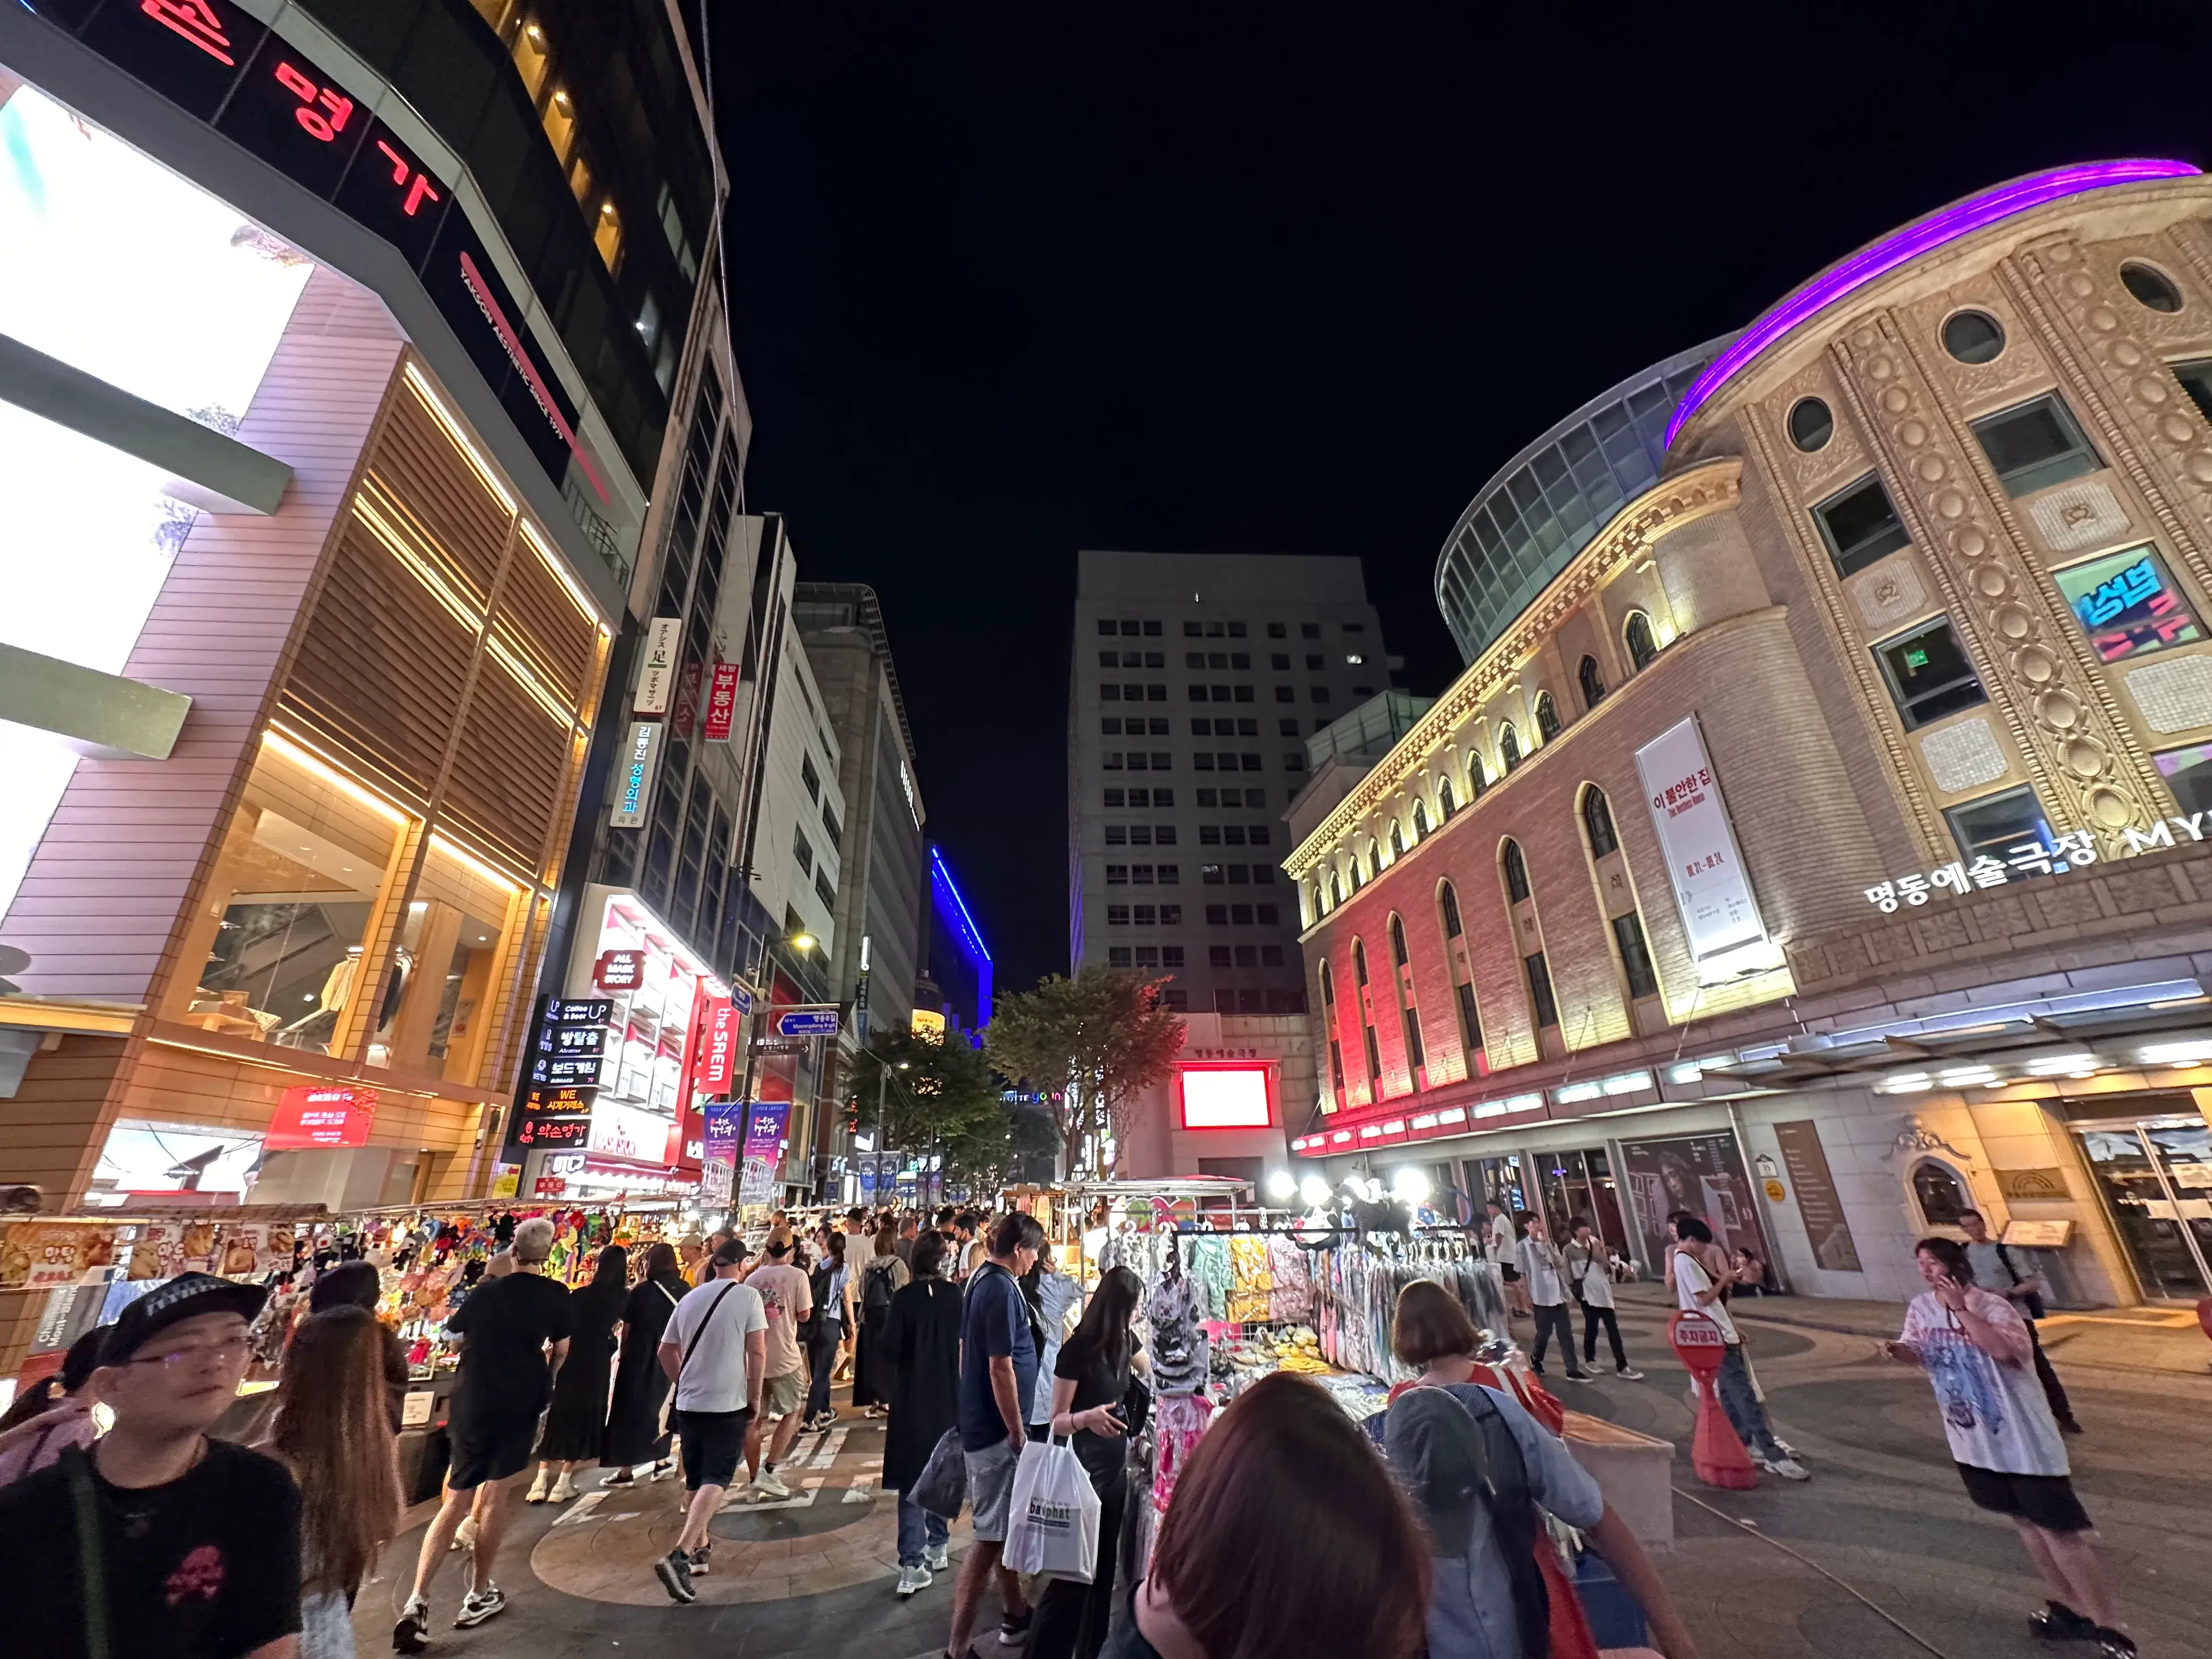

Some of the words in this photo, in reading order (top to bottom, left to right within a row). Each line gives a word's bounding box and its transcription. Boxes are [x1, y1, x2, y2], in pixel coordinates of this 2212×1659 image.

[460, 267, 494, 325] YAKSON
[492, 324, 532, 385] AESTHETIC
[531, 384, 550, 419] SINCE
[547, 415, 564, 441] 1979
[651, 650, 666, 663] 足
[710, 674, 734, 724] 부동산
[1654, 792, 1666, 809] 이
[1665, 774, 1699, 805] 불안한
[1697, 767, 1712, 786] 집
[1864, 830, 2097, 913] 명동예술극장
[2124, 810, 2212, 853] MY
[613, 954, 633, 963] ALL
[607, 964, 635, 973] MASK
[604, 974, 634, 984] STORY
[715, 1008, 731, 1029] the
[561, 1031, 599, 1046] 방탈출
[550, 1062, 597, 1074] 보드게임
[560, 1089, 577, 1100] WE
[546, 1100, 584, 1110] 시계거래소
[537, 1122, 586, 1139] 약손명가
